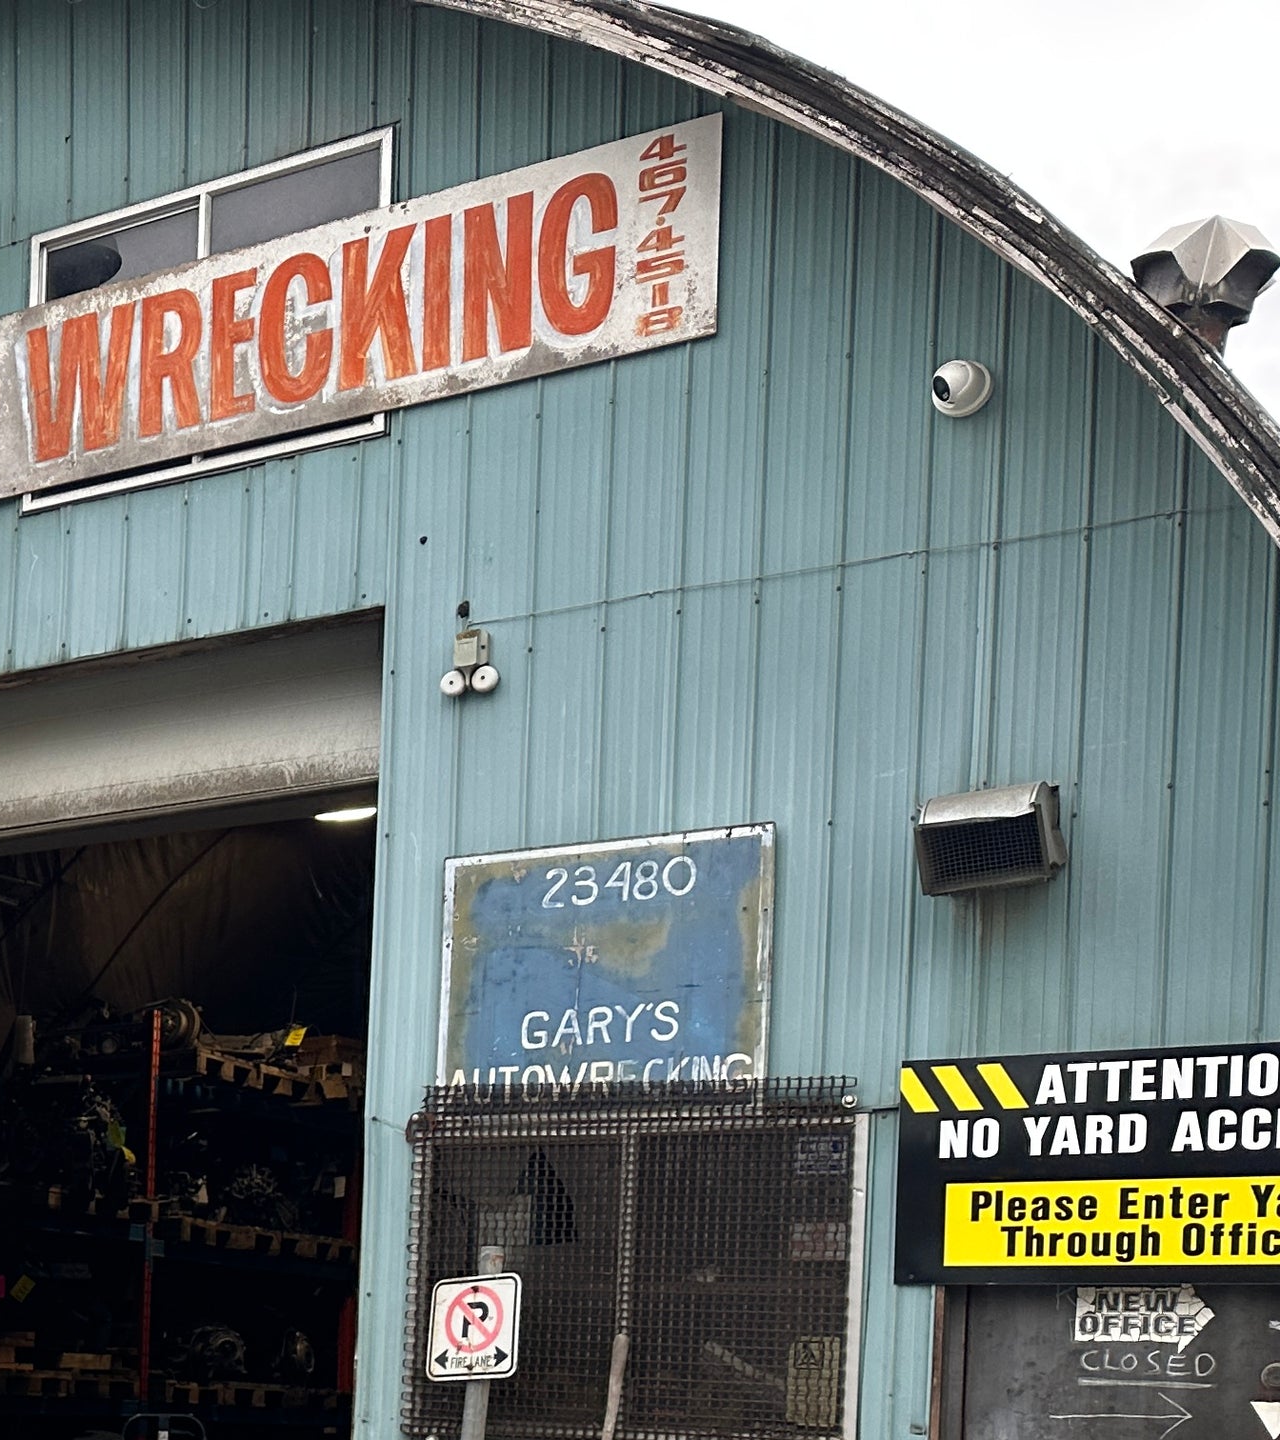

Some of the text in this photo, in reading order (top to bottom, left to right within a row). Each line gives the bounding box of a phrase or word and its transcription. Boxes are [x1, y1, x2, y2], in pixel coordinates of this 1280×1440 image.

[26, 171, 619, 462] WRECKING
[541, 854, 698, 909] 23480
[520, 1000, 680, 1051] GARY'S
[939, 1107, 1280, 1159] NO YARD ACC
[970, 1184, 1280, 1222] Please Enter Y
[1001, 1223, 1161, 1263] Through
[1094, 1289, 1178, 1313] NEW
[1078, 1313, 1197, 1337] OFFICE
[450, 1356, 468, 1369] FIRE
[1080, 1349, 1216, 1377] CLOSED
